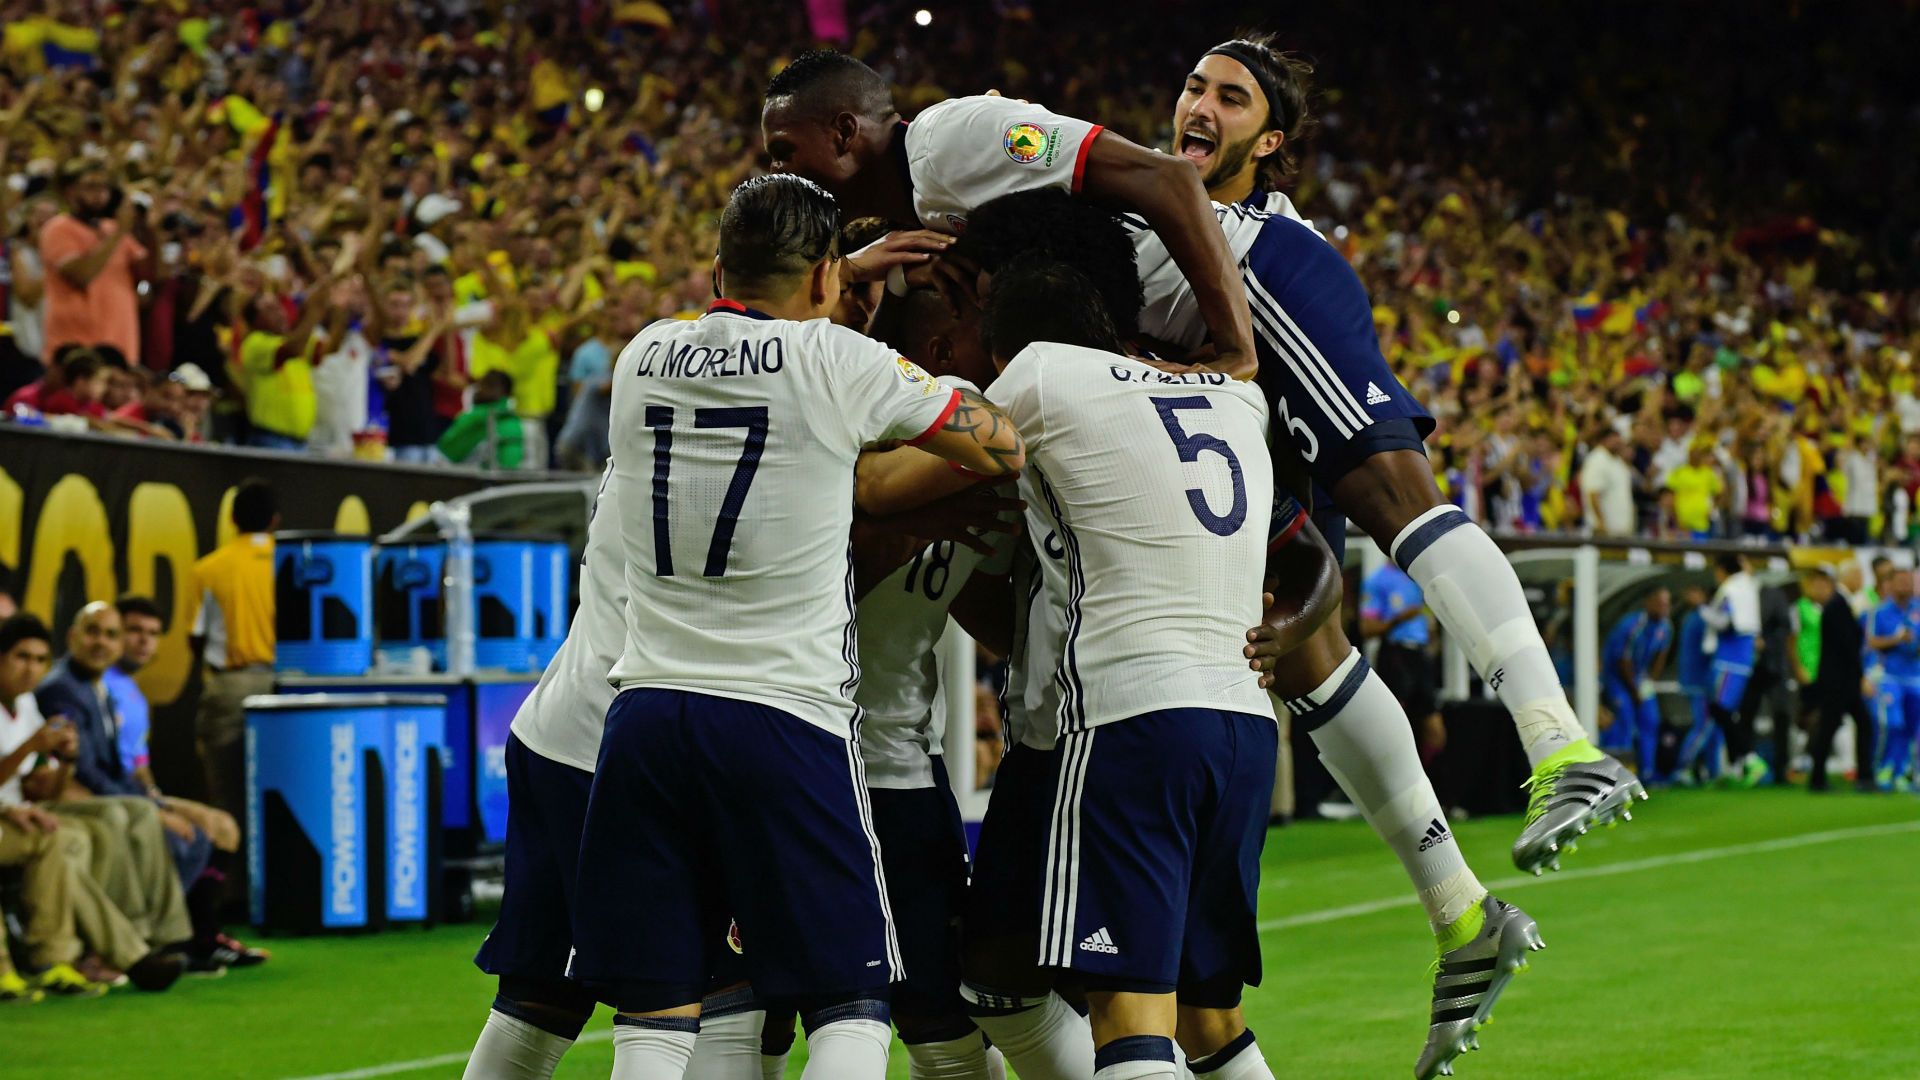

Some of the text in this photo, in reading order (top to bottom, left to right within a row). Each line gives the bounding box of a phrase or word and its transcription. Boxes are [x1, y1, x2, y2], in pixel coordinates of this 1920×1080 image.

[1045, 127, 1060, 168] CONMEBOL
[636, 336, 783, 378] D. MORENO
[1278, 395, 1319, 463] 3
[645, 406, 769, 577] 17
[1149, 395, 1248, 537] 5
[904, 538, 955, 601] 18
[1079, 942, 1119, 955] adidas
